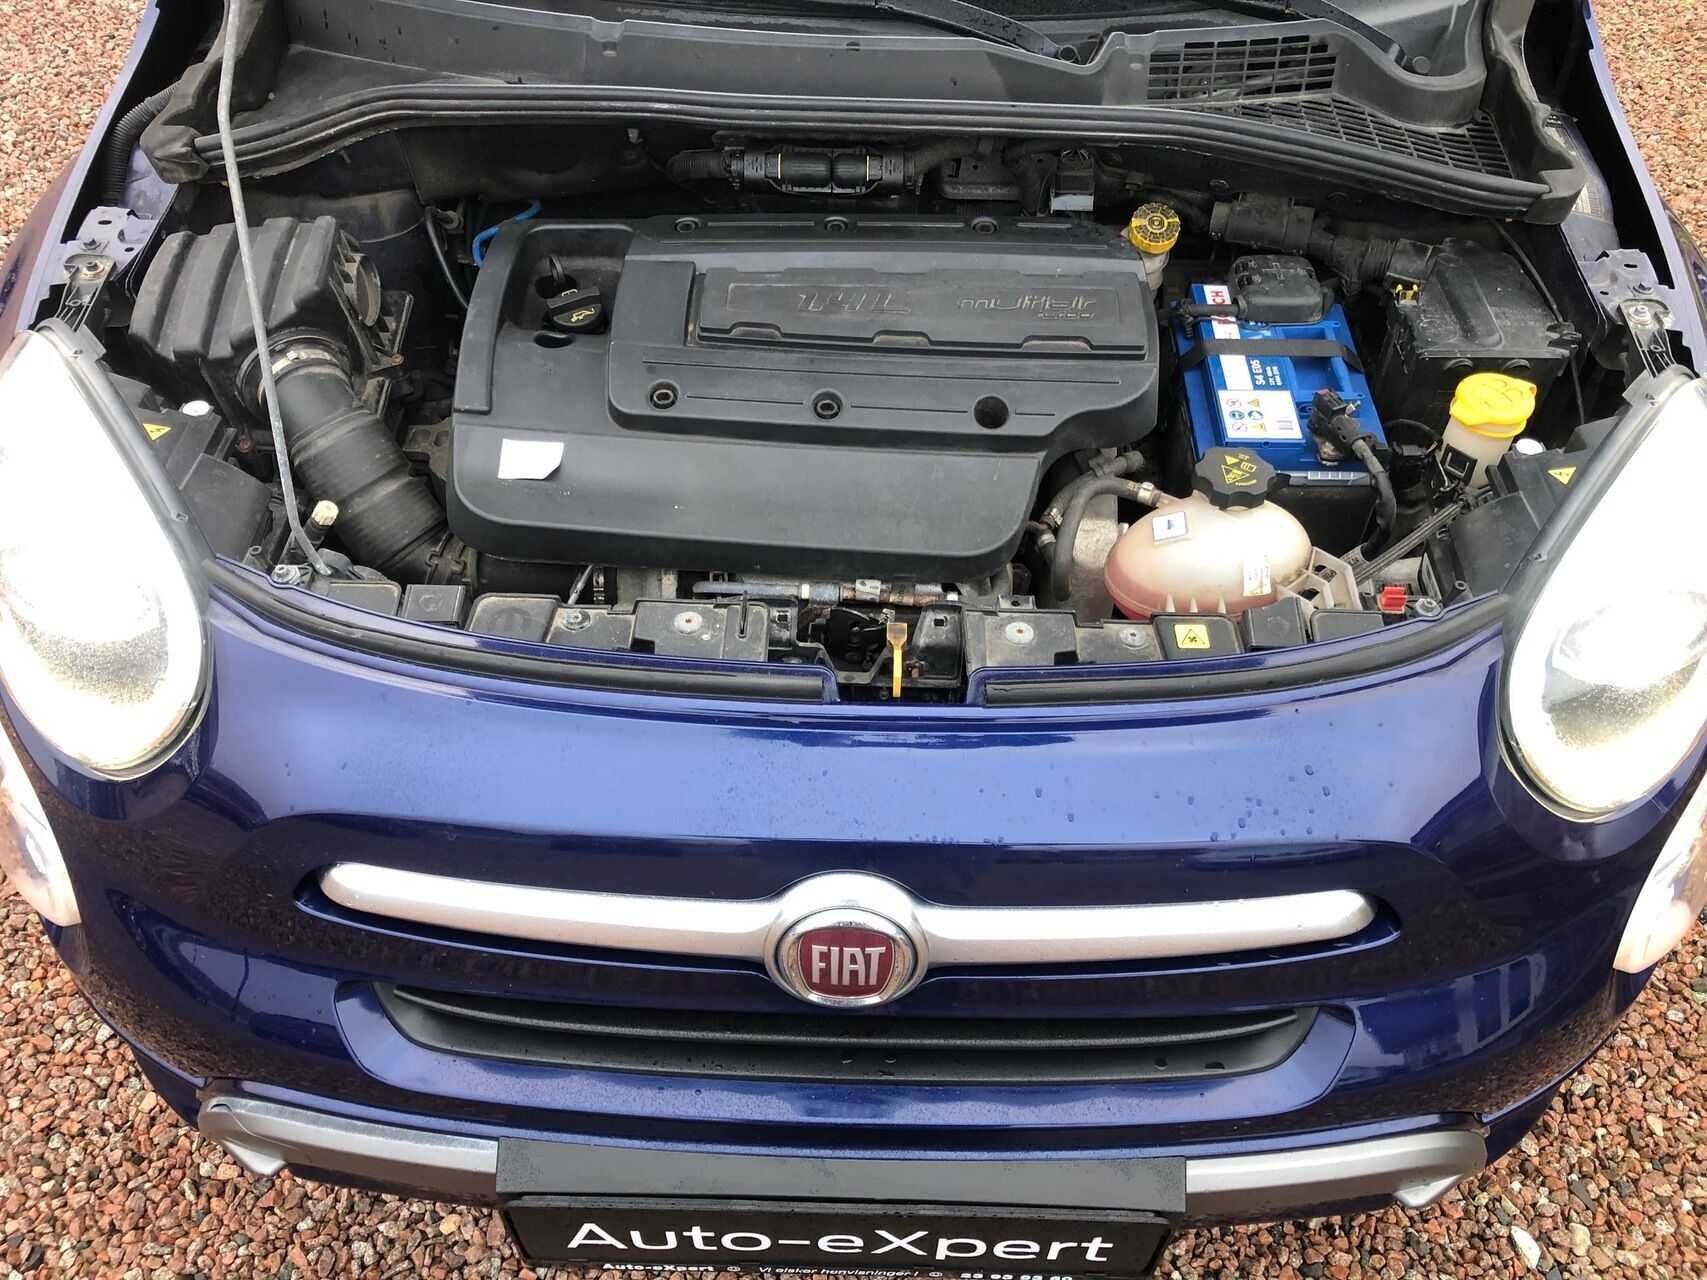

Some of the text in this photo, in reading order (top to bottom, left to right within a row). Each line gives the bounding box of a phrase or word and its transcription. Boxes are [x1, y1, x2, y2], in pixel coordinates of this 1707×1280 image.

[811, 944, 887, 986] FIAT
[566, 1222, 1114, 1261] Auto-eXpert
[602, 1263, 715, 1272] Auto-eXpert
